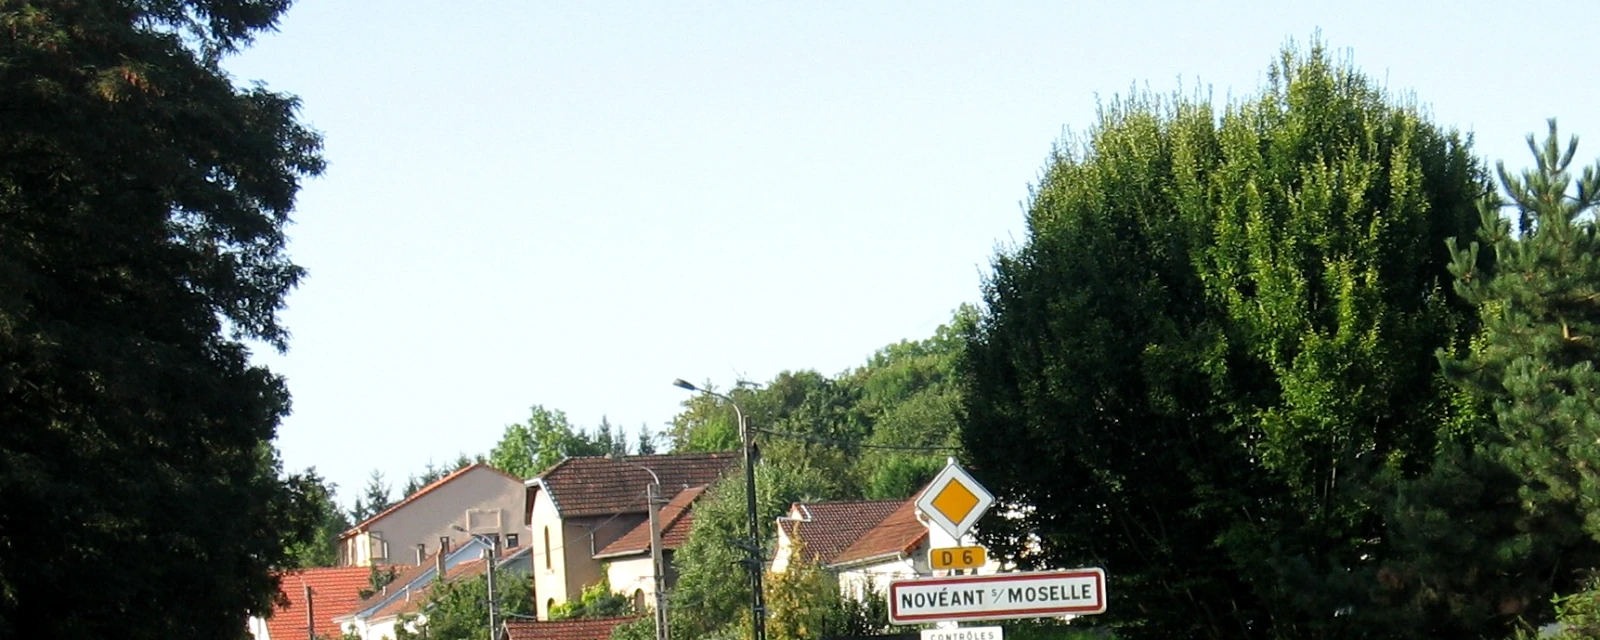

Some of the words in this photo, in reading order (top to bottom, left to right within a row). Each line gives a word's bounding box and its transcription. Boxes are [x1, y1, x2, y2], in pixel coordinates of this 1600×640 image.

[942, 551, 952, 566] D
[962, 550, 973, 565] 6
[902, 588, 985, 609] NOVÉANT
[1008, 584, 1092, 603] MOSELLE
[930, 630, 995, 640] CONTRÔLES
